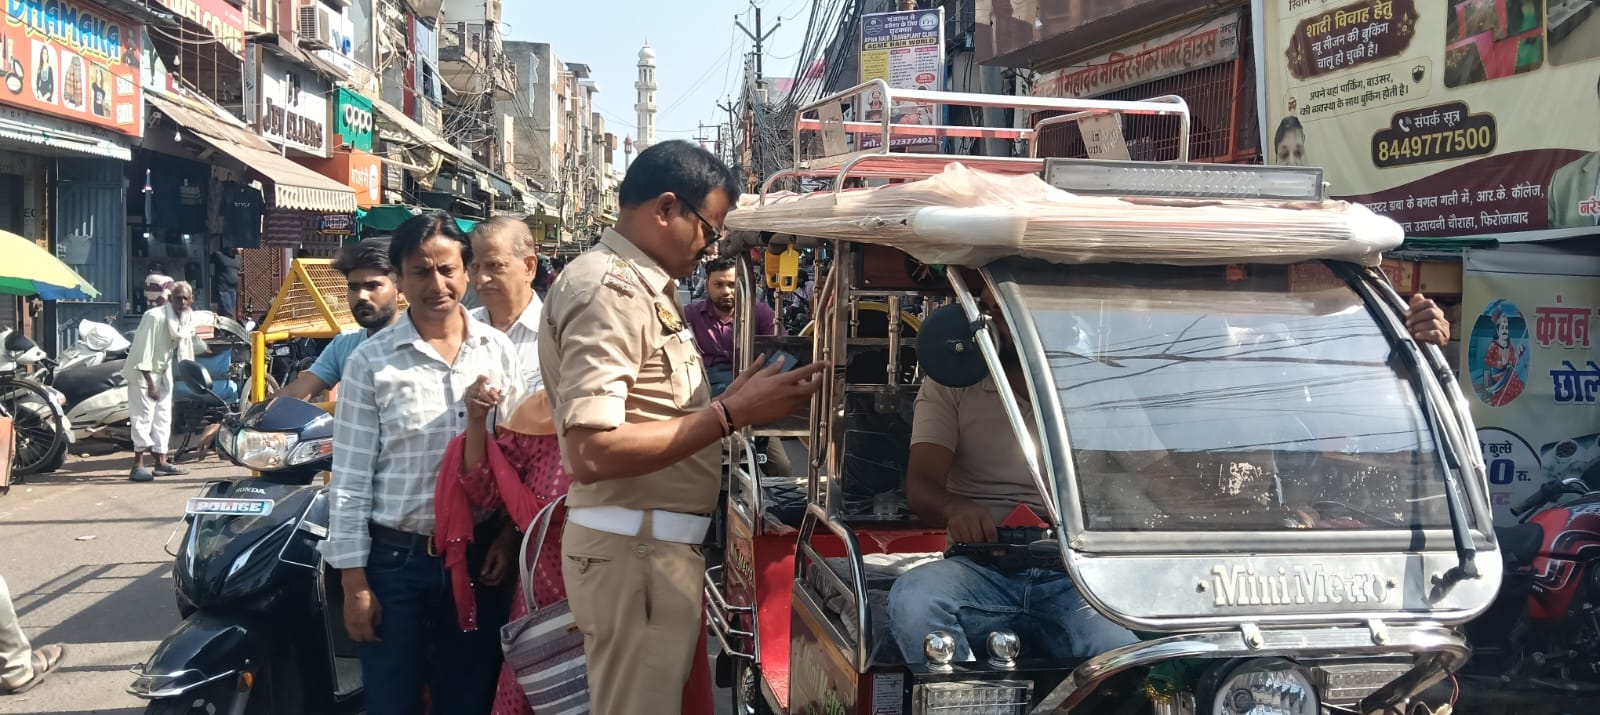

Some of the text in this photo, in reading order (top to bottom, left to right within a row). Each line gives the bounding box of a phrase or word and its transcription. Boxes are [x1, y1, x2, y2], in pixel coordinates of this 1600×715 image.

[7, 0, 121, 65] DHAMAKA
[168, 0, 242, 55] WELCOME
[1306, 0, 1393, 38] शादी विवाह हेतु
[1312, 21, 1390, 55] न्यू सीजन की बुकिंग
[1064, 62, 1098, 96] महादेव
[1183, 29, 1218, 66] हाउस
[1317, 57, 1335, 70] चालू
[1335, 50, 1344, 65] हो
[1346, 43, 1365, 65] चुकी
[1336, 97, 1344, 108] के
[1360, 89, 1381, 107] बुकिंग
[1381, 85, 1398, 99] होती
[263, 97, 323, 148] JEWELLERS
[1414, 110, 1461, 128] संपर्क सूत्र
[1378, 125, 1490, 161] 8449777500
[1406, 194, 1415, 209] के
[1416, 196, 1438, 209] बगल
[1440, 192, 1459, 206] गली
[1511, 181, 1545, 199] कॉलेज,
[1414, 215, 1446, 233] उसायनी
[1480, 210, 1529, 227] फिरोजाबाद
[1536, 295, 1592, 347] कंचन
[197, 501, 262, 512] POLICE
[235, 487, 266, 495] HONDA
[1211, 563, 1389, 608] Mini Metro
